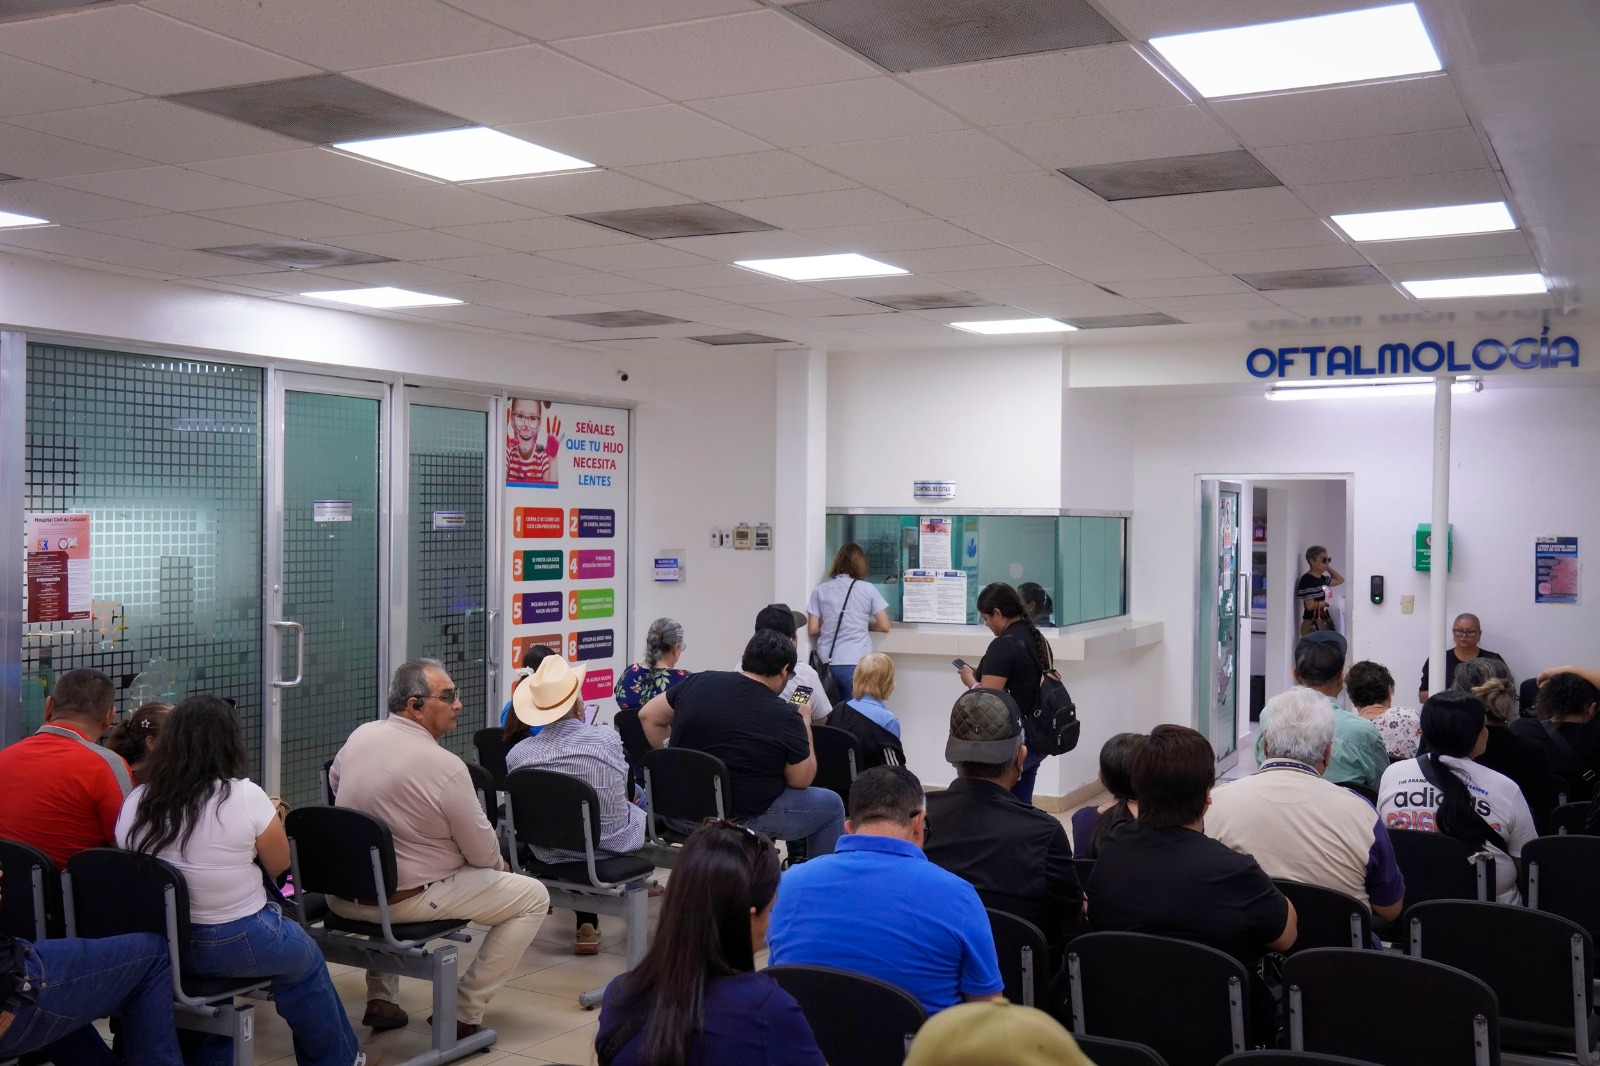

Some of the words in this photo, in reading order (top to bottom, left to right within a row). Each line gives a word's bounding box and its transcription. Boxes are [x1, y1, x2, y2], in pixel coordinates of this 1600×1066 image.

[1246, 326, 1580, 378] OFTALMOLOGÍA
[576, 420, 615, 436] SEÑALES
[566, 438, 586, 451] QUE
[588, 440, 601, 452] TU
[602, 442, 624, 454] HIJO
[573, 456, 616, 470] NECESITA
[578, 474, 612, 486] LENTES
[516, 516, 522, 532] 1
[570, 516, 578, 532] 2
[513, 558, 522, 575] 3
[569, 558, 578, 574] 4
[513, 602, 522, 618] 5
[569, 598, 577, 614] 6
[513, 646, 522, 662] 7
[569, 640, 577, 656] 8
[1468, 784, 1489, 795] TRIPES
[1394, 787, 1491, 816] adis
